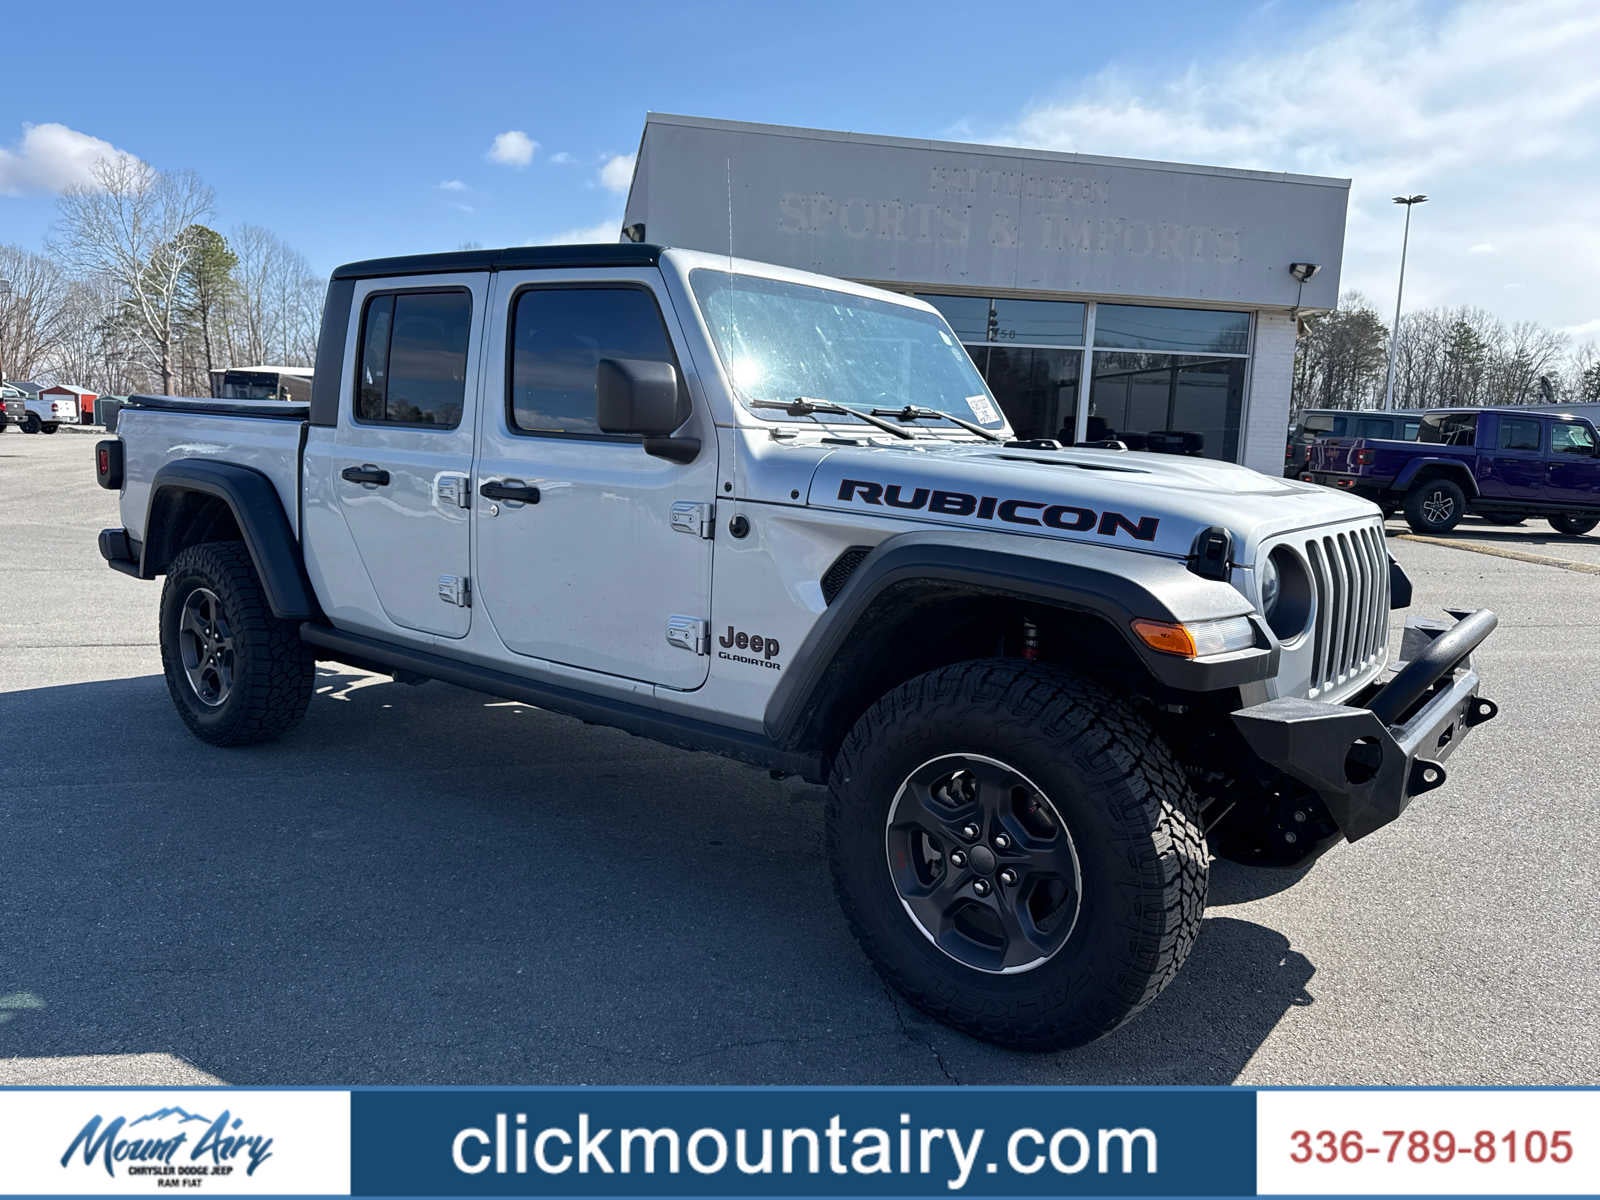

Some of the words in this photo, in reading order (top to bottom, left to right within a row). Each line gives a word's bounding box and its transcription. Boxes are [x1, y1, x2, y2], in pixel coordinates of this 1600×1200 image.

[777, 193, 970, 243] SPORTS
[988, 208, 1023, 248] &
[1040, 213, 1243, 265] IMPORTS
[837, 479, 1160, 542] RUBICON
[718, 651, 781, 671] GLADIATOR
[719, 626, 780, 660] Jeep
